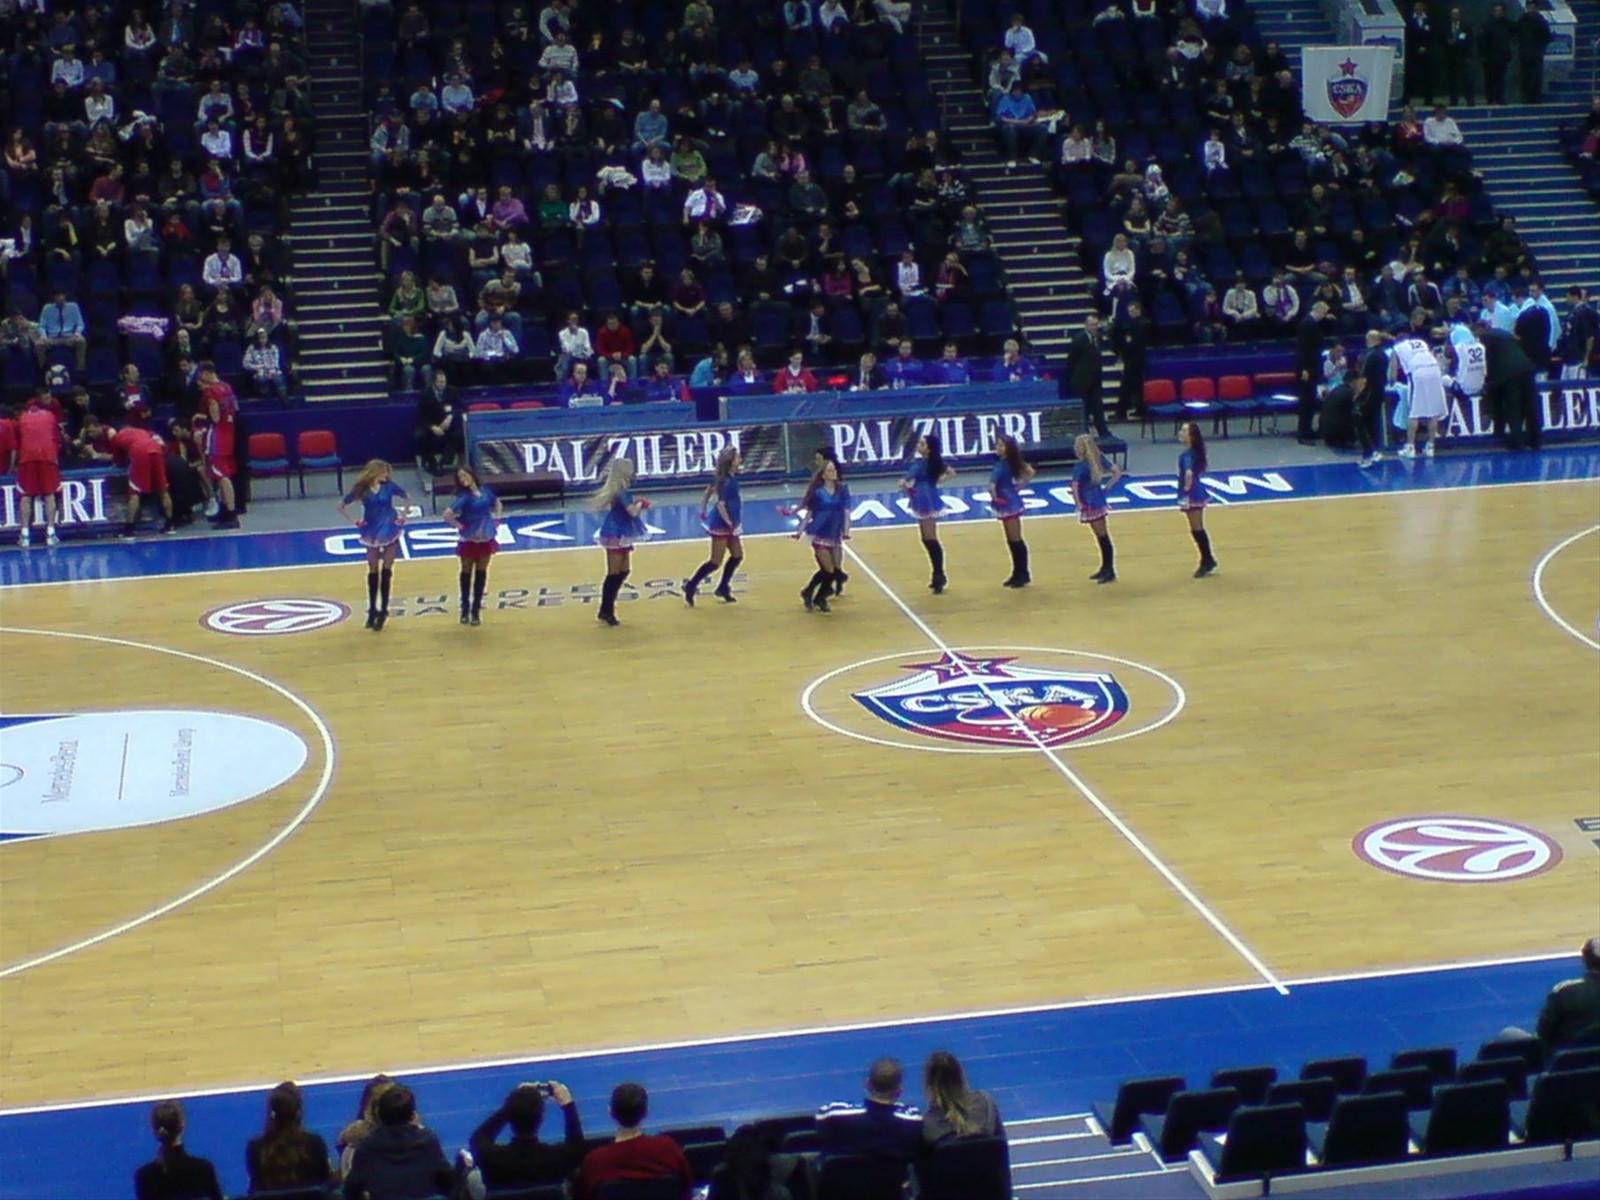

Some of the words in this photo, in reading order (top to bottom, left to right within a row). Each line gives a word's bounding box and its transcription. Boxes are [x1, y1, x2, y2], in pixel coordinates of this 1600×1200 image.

[1467, 346, 1484, 364] 32
[831, 420, 904, 464] PAL
[913, 411, 1043, 458] ZILERI
[1435, 395, 1495, 438] AL
[522, 439, 598, 482] PAL
[900, 684, 1098, 713] CSKA
